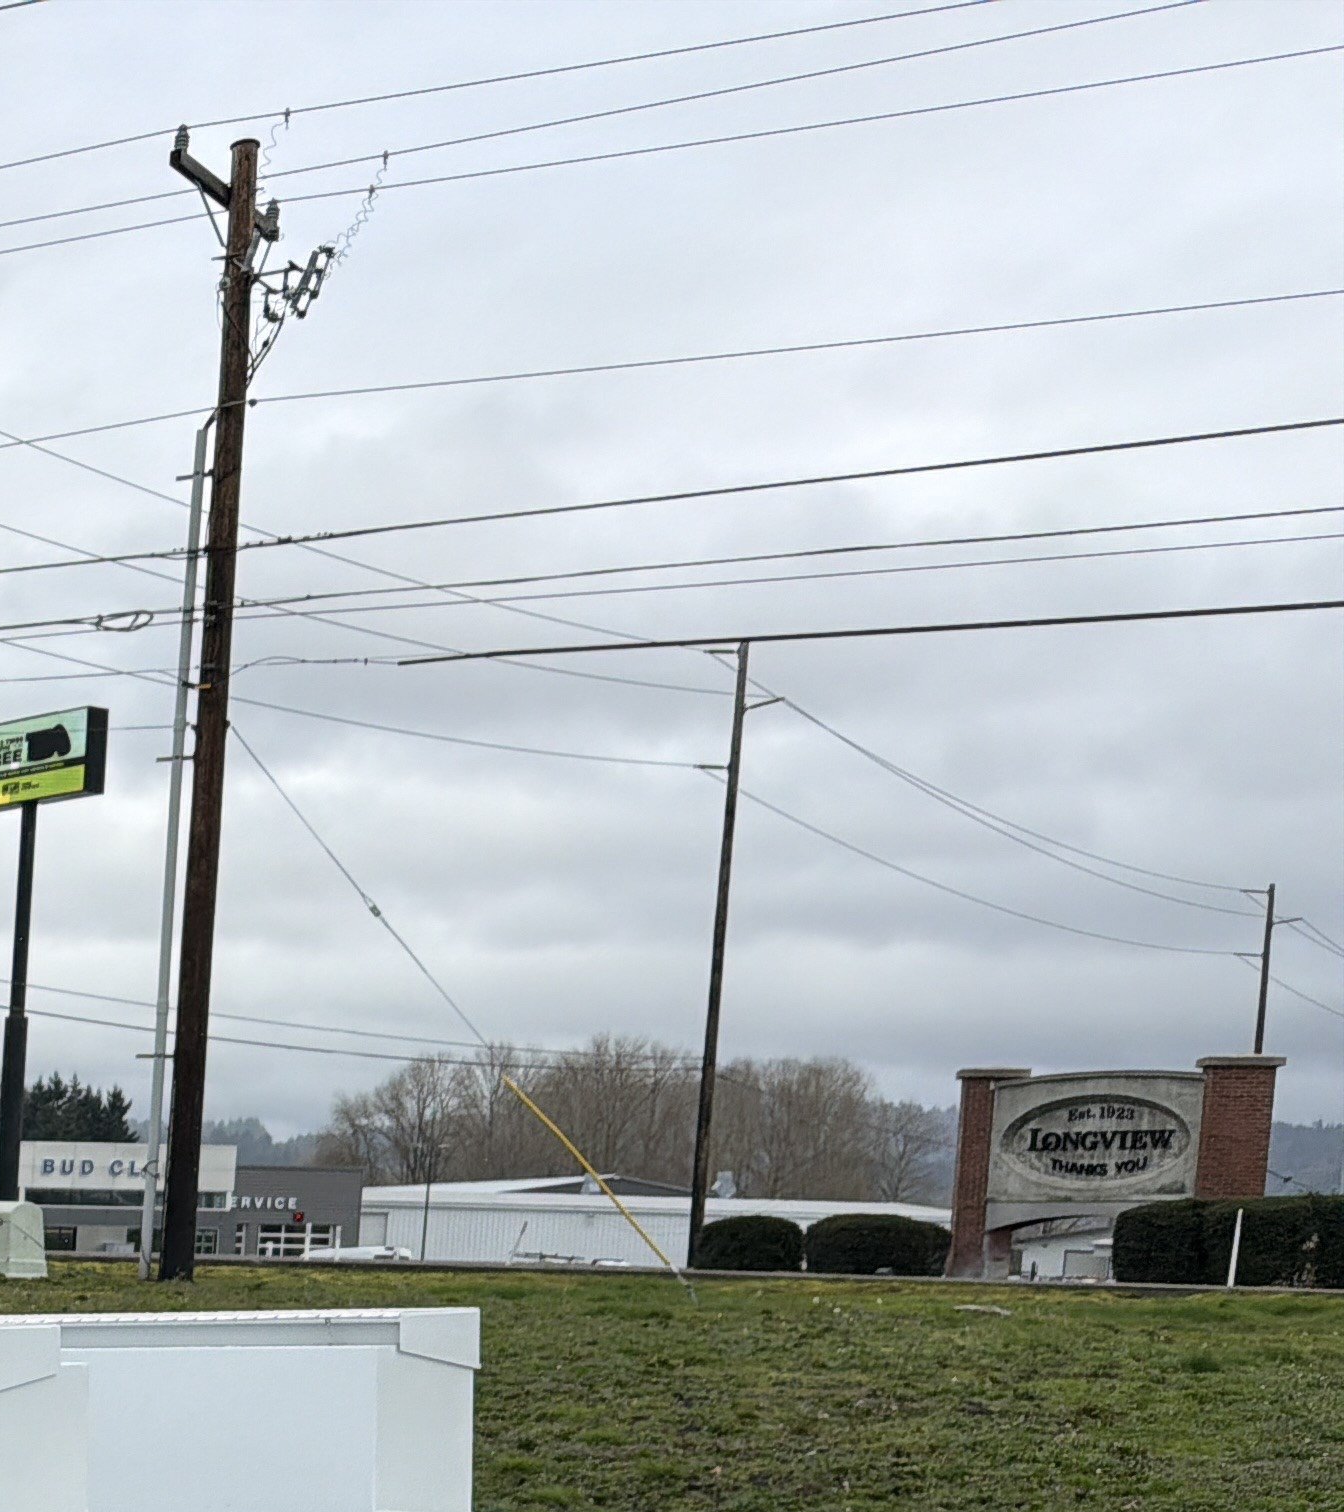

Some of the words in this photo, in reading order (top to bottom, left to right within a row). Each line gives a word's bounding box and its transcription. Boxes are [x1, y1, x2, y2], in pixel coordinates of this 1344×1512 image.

[1098, 1105, 1136, 1121] 1923
[41, 1158, 95, 1176] BUD
[1050, 1157, 1108, 1177] THANKS
[1114, 1156, 1149, 1174] YOU
[230, 1196, 298, 1210] ERVICE
